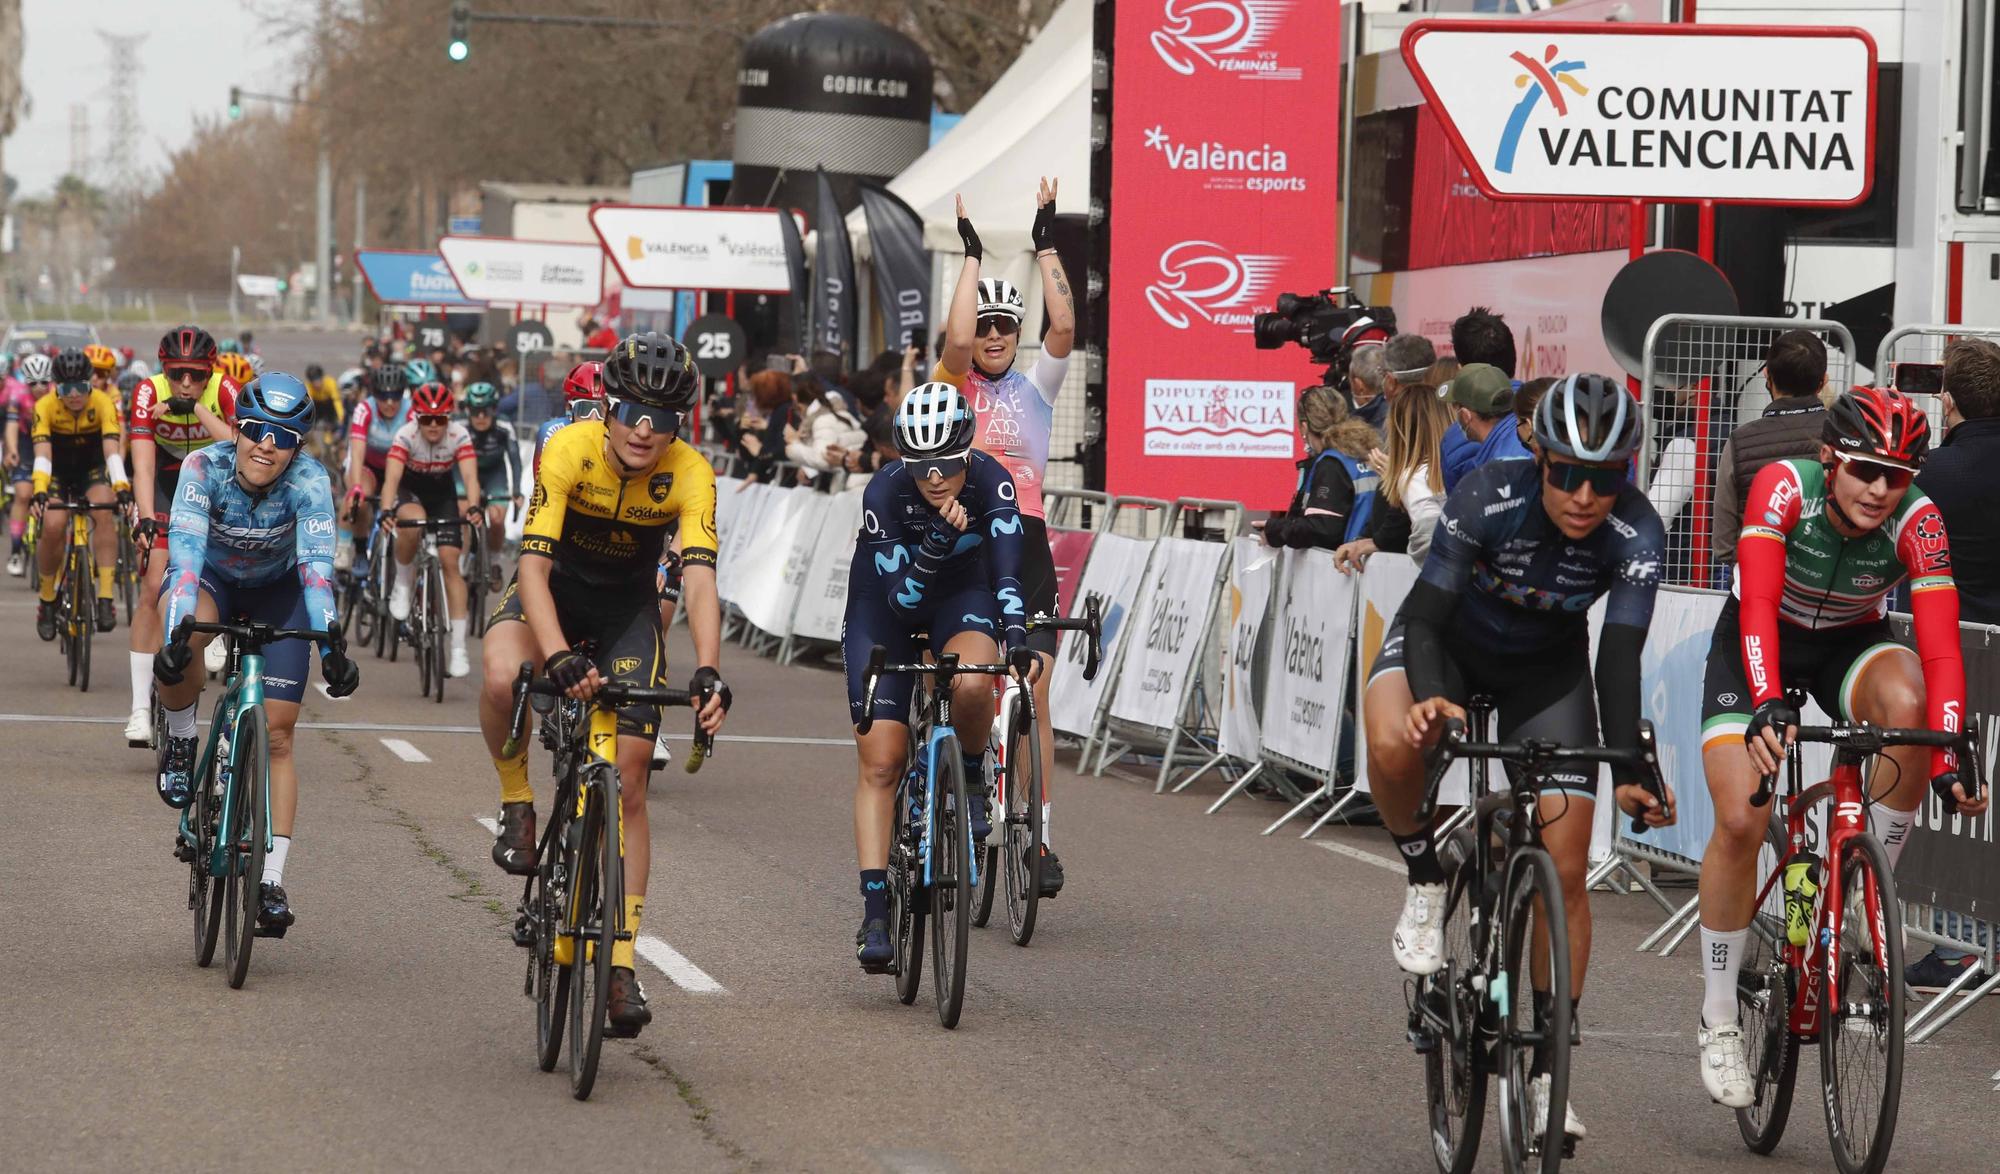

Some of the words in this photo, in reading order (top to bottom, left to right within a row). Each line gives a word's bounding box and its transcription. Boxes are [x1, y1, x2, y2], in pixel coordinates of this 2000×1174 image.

[1219, 57, 1278, 71] FÉMINAS
[823, 74, 908, 97] GOBIK.COM
[1597, 86, 1853, 124] COMUNITAT
[1163, 141, 1287, 172] València
[1538, 125, 1855, 171] VALENCIANA
[1247, 176, 1307, 193] esports
[1213, 311, 1256, 325] FÉMIN
[421, 328, 445, 347] 75
[516, 331, 545, 353] 50
[697, 332, 732, 359] 25
[136, 384, 153, 419] CAMS
[974, 390, 1024, 413] UAE
[1262, 390, 1286, 400] DE
[1152, 402, 1287, 425] VALÈNCIA
[155, 423, 210, 440] CAM
[985, 418, 1020, 437] ADQ
[186, 485, 211, 510] Buff
[308, 518, 334, 535] Buff
[1745, 635, 1768, 697] VERGE
[1884, 821, 1909, 846] TALK
[1712, 942, 1729, 971] LESS
